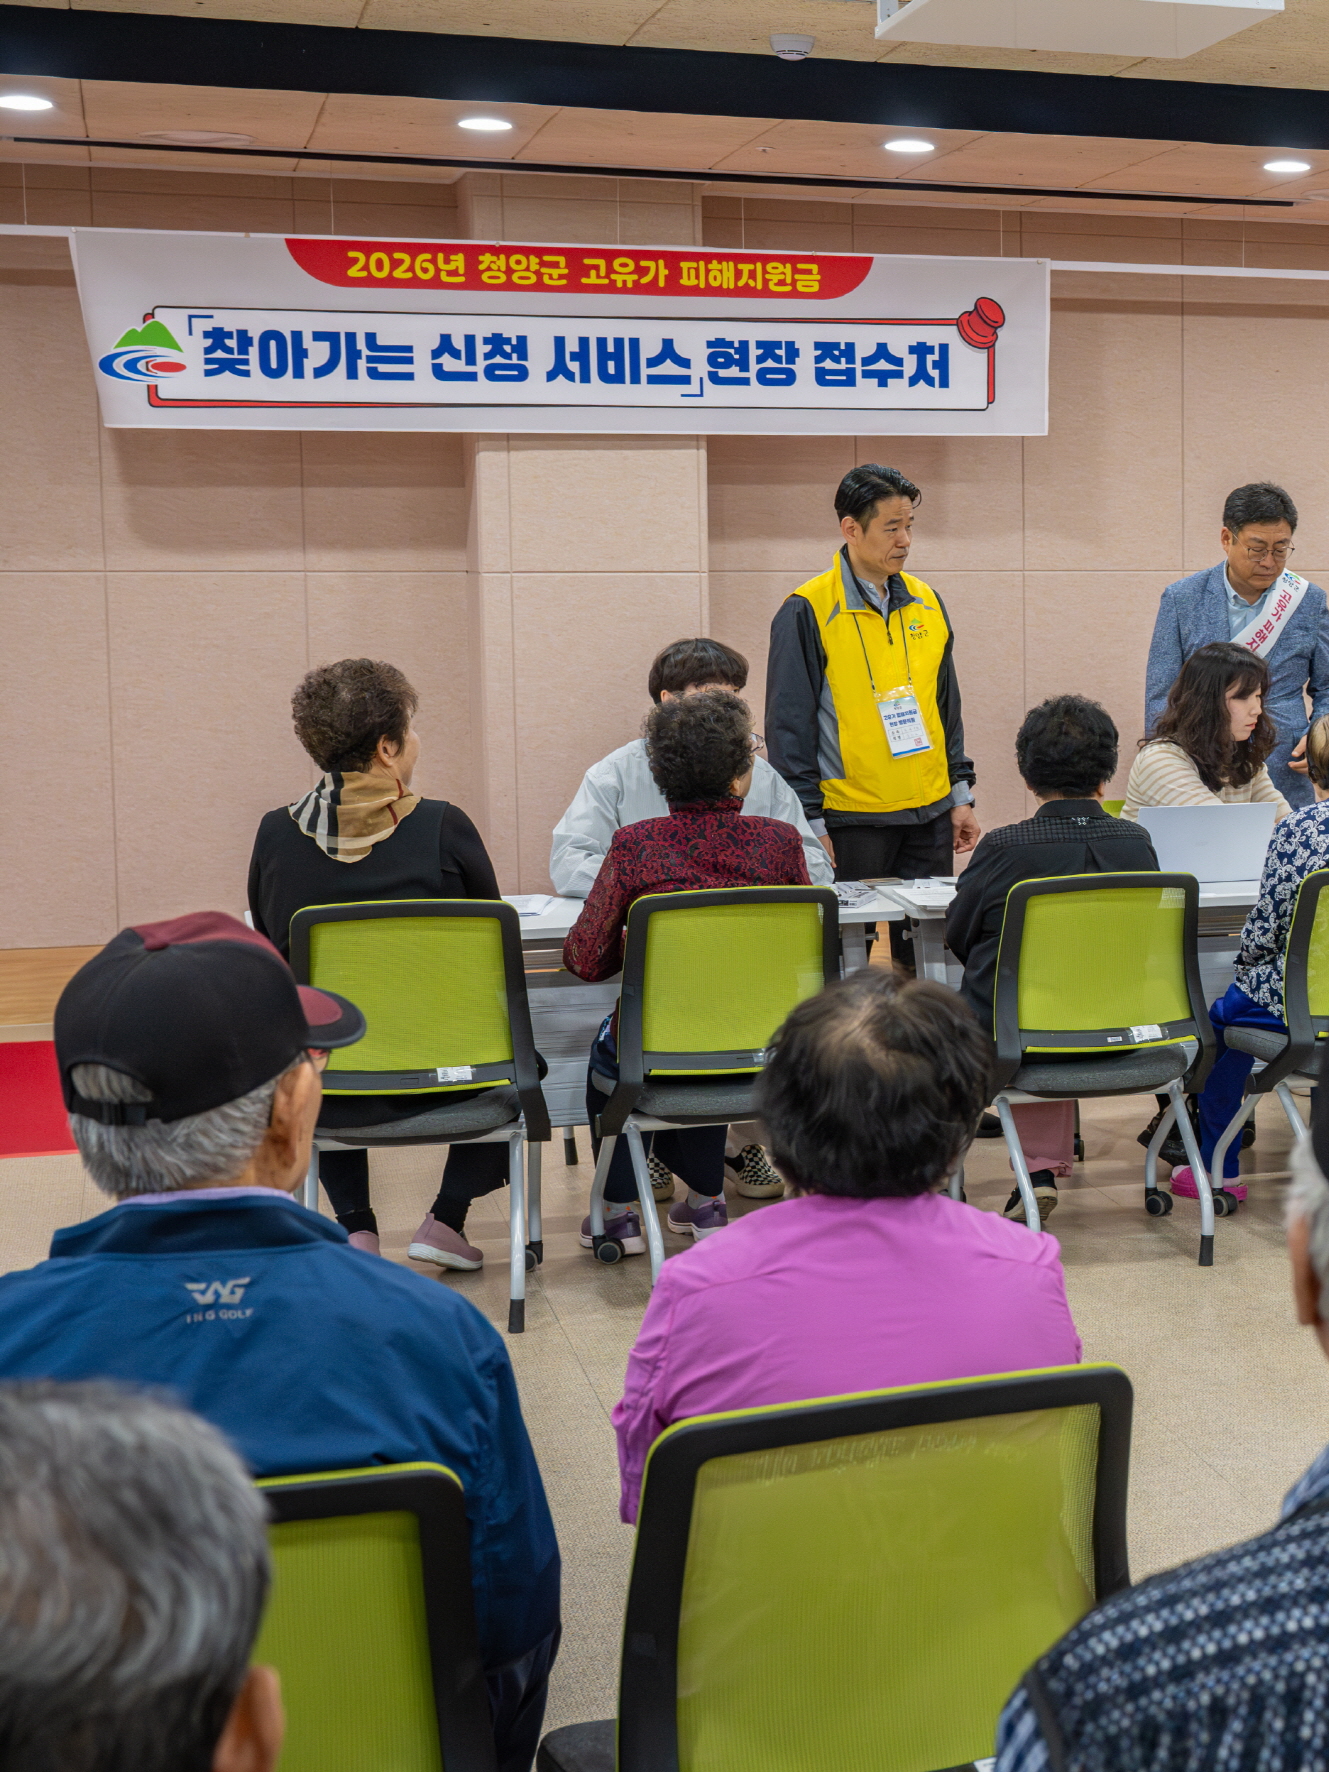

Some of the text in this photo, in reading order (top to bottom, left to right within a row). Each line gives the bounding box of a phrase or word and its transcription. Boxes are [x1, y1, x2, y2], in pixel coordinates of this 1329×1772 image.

[346, 251, 822, 293] 2026년 청양군 고유가 피해지원금
[431, 332, 530, 383] 신청
[705, 336, 801, 388] 현장
[813, 340, 950, 390] 접수처
[1271, 589, 1293, 622] 고유가
